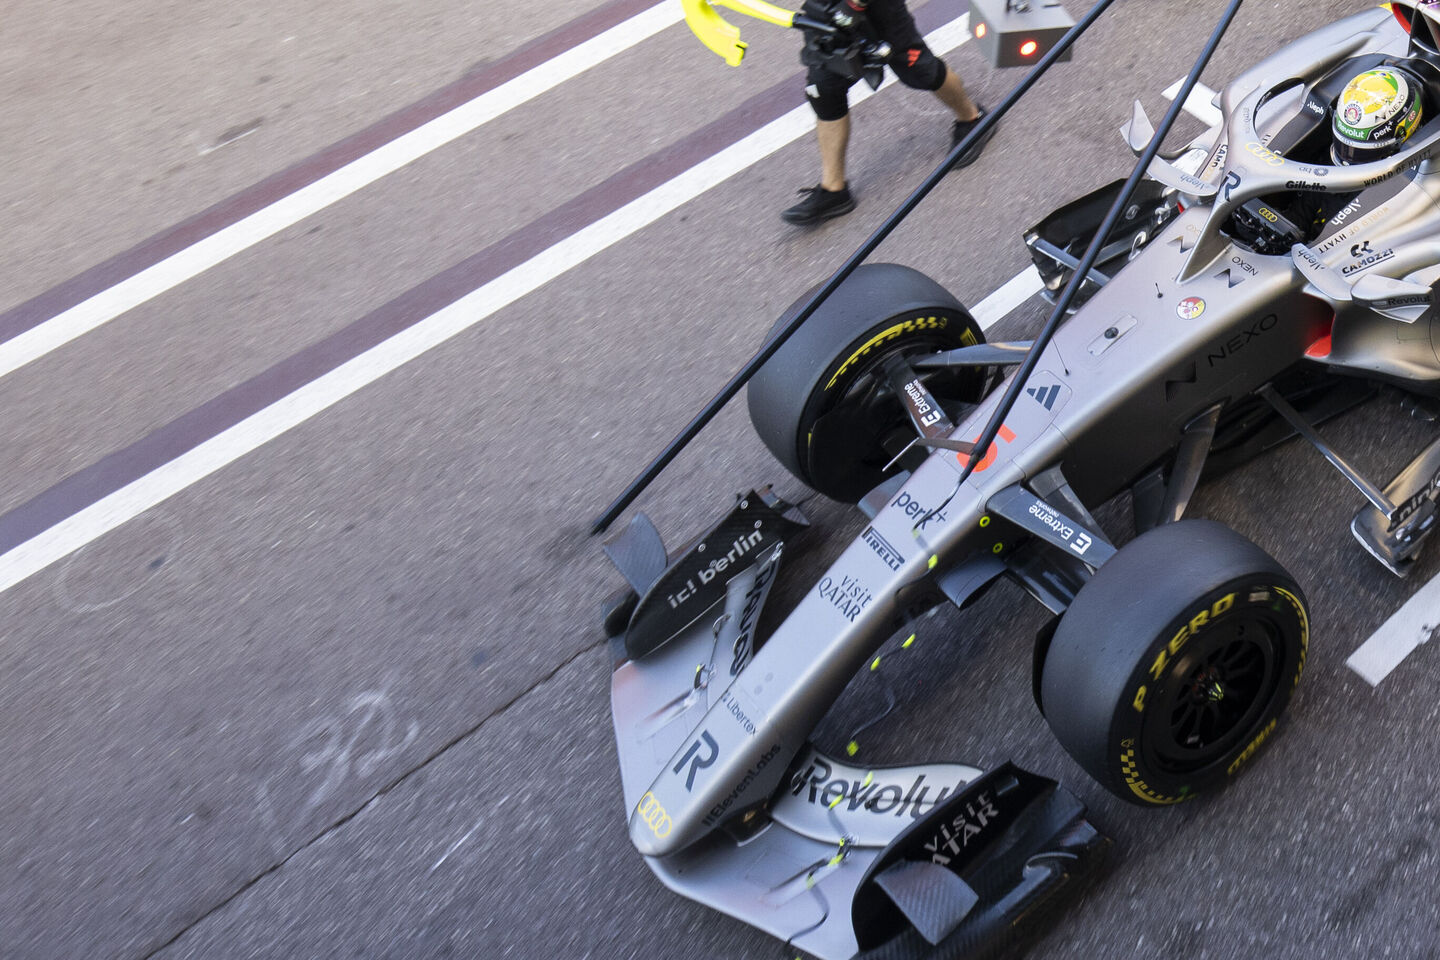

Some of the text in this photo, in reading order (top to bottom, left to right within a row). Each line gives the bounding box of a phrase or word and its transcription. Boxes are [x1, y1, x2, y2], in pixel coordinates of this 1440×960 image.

[1337, 120, 1365, 139] Revolut
[1231, 255, 1259, 277] NEXO
[1341, 247, 1395, 275] CAMOZZI
[1207, 313, 1278, 368] NEXO
[904, 382, 931, 415] Extreme
[1028, 504, 1075, 541] Extreme
[697, 528, 764, 586] berlin
[861, 525, 906, 571] PIRELLI
[818, 576, 862, 623] QATAR
[841, 574, 873, 609] visit
[1150, 592, 1238, 681] ZERO
[923, 791, 992, 852] visit
[931, 802, 1000, 866] ATAR
